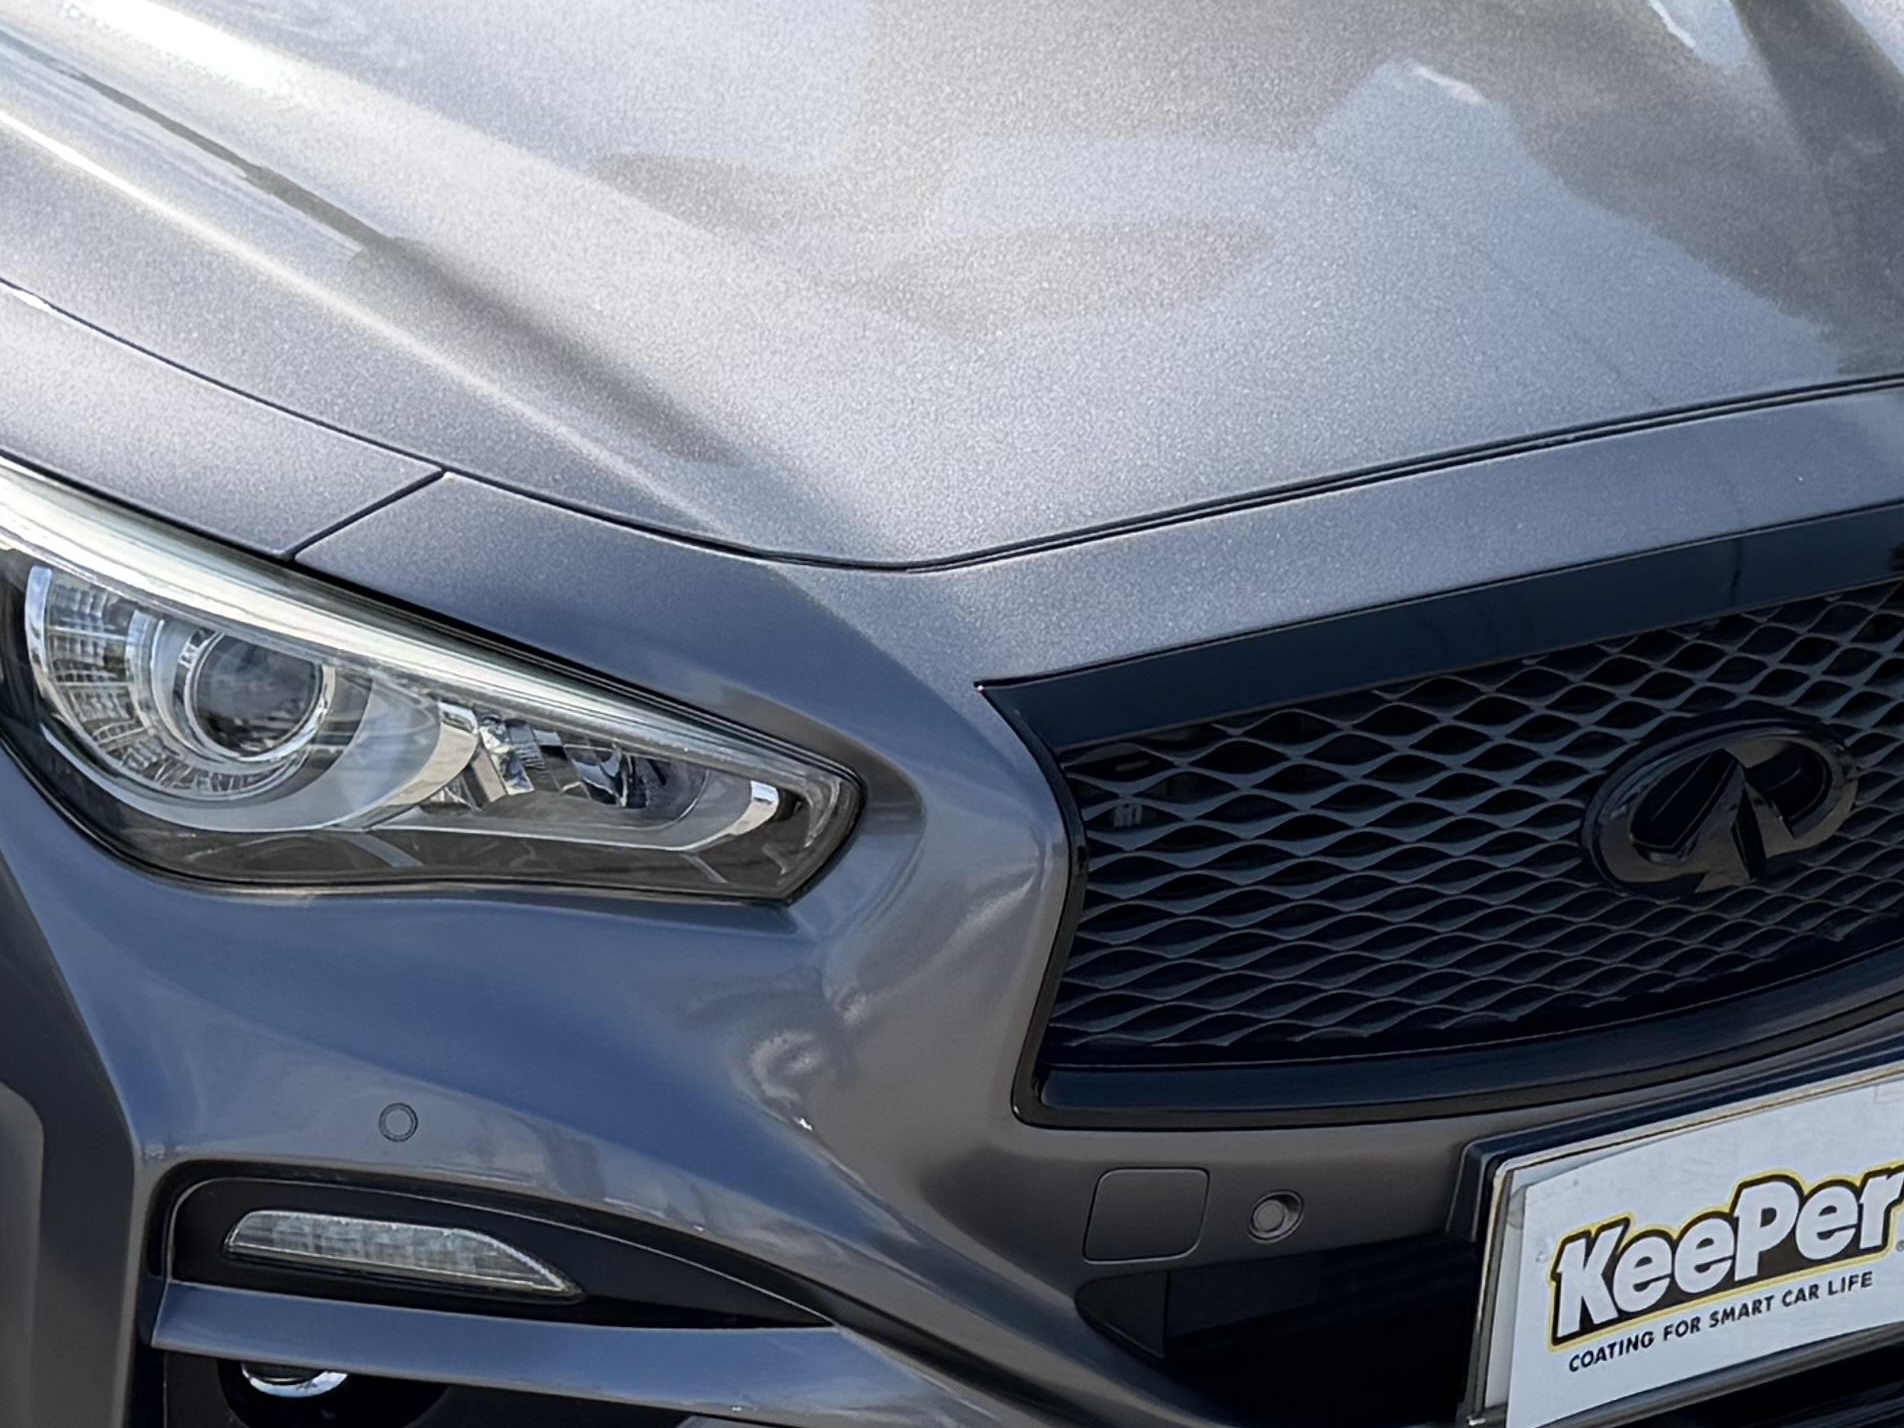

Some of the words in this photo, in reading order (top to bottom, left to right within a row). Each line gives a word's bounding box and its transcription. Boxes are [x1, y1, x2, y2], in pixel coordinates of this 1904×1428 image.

[1568, 1330, 1654, 1373] COATING
[1662, 1316, 1701, 1341] FOR
[1708, 1294, 1775, 1329] SMART
[1781, 1280, 1820, 1308] CAR
[1827, 1270, 1874, 1296] LIFE
